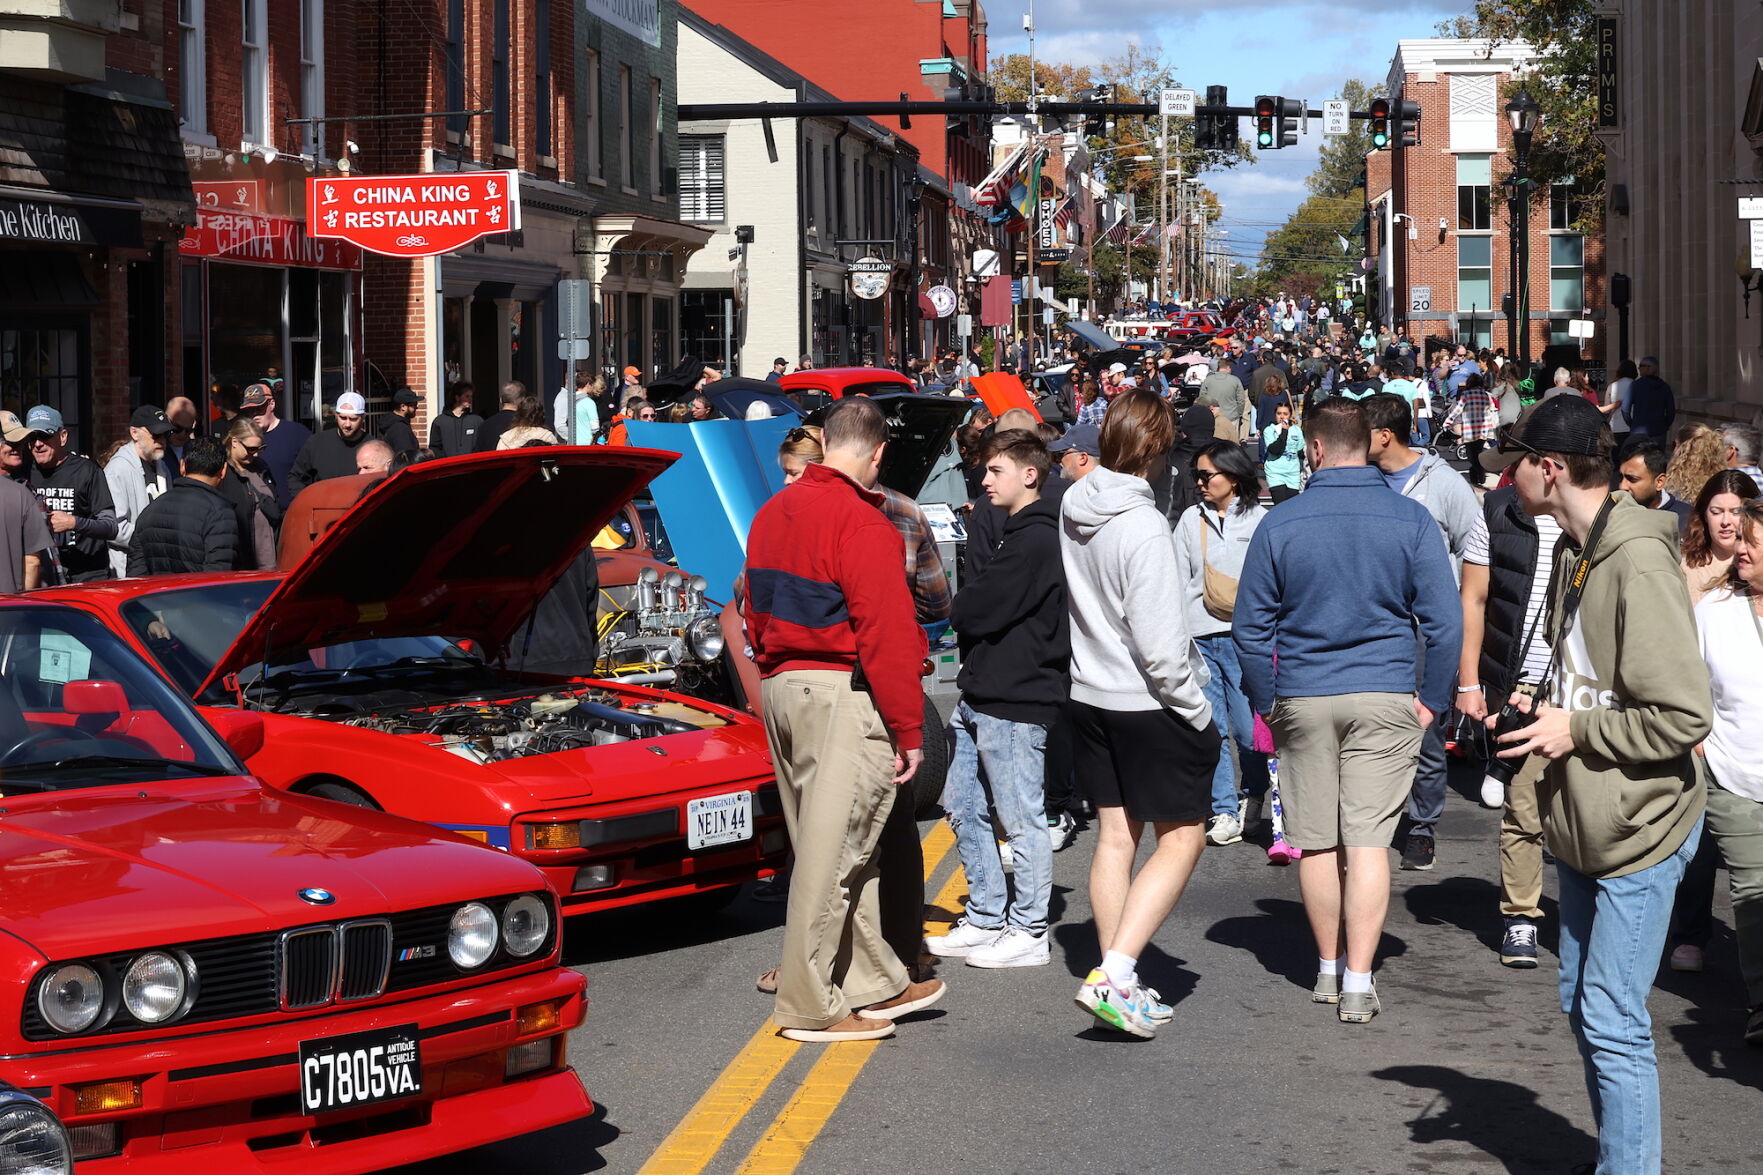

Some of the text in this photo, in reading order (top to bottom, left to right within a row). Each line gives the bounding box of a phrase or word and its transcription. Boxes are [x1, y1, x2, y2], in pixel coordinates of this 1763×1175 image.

[1601, 28, 1615, 117] PRIMIS
[1164, 93, 1191, 101] DELAYED
[1167, 103, 1188, 111] GREEN
[1329, 102, 1342, 110] NO
[353, 185, 470, 204] CHINA KING
[19, 203, 81, 241] Kitchen
[345, 208, 479, 228] RESTAURANT
[1041, 201, 1051, 247] SHOES
[214, 219, 274, 259] CHINA
[283, 223, 324, 263] KING
[848, 263, 892, 271] REBELLION
[1412, 300, 1430, 311] 20
[46, 488, 58, 497] OF
[58, 488, 74, 498] THE
[46, 499, 75, 511] FREE
[1573, 559, 1589, 588] Nikon
[705, 797, 736, 809] VIRGINIA
[697, 805, 745, 837] NEIN 44
[409, 945, 436, 960] M3
[387, 1040, 416, 1054] ANTIQUE
[387, 1051, 416, 1066] VEHICLE
[304, 1046, 386, 1110] C7805
